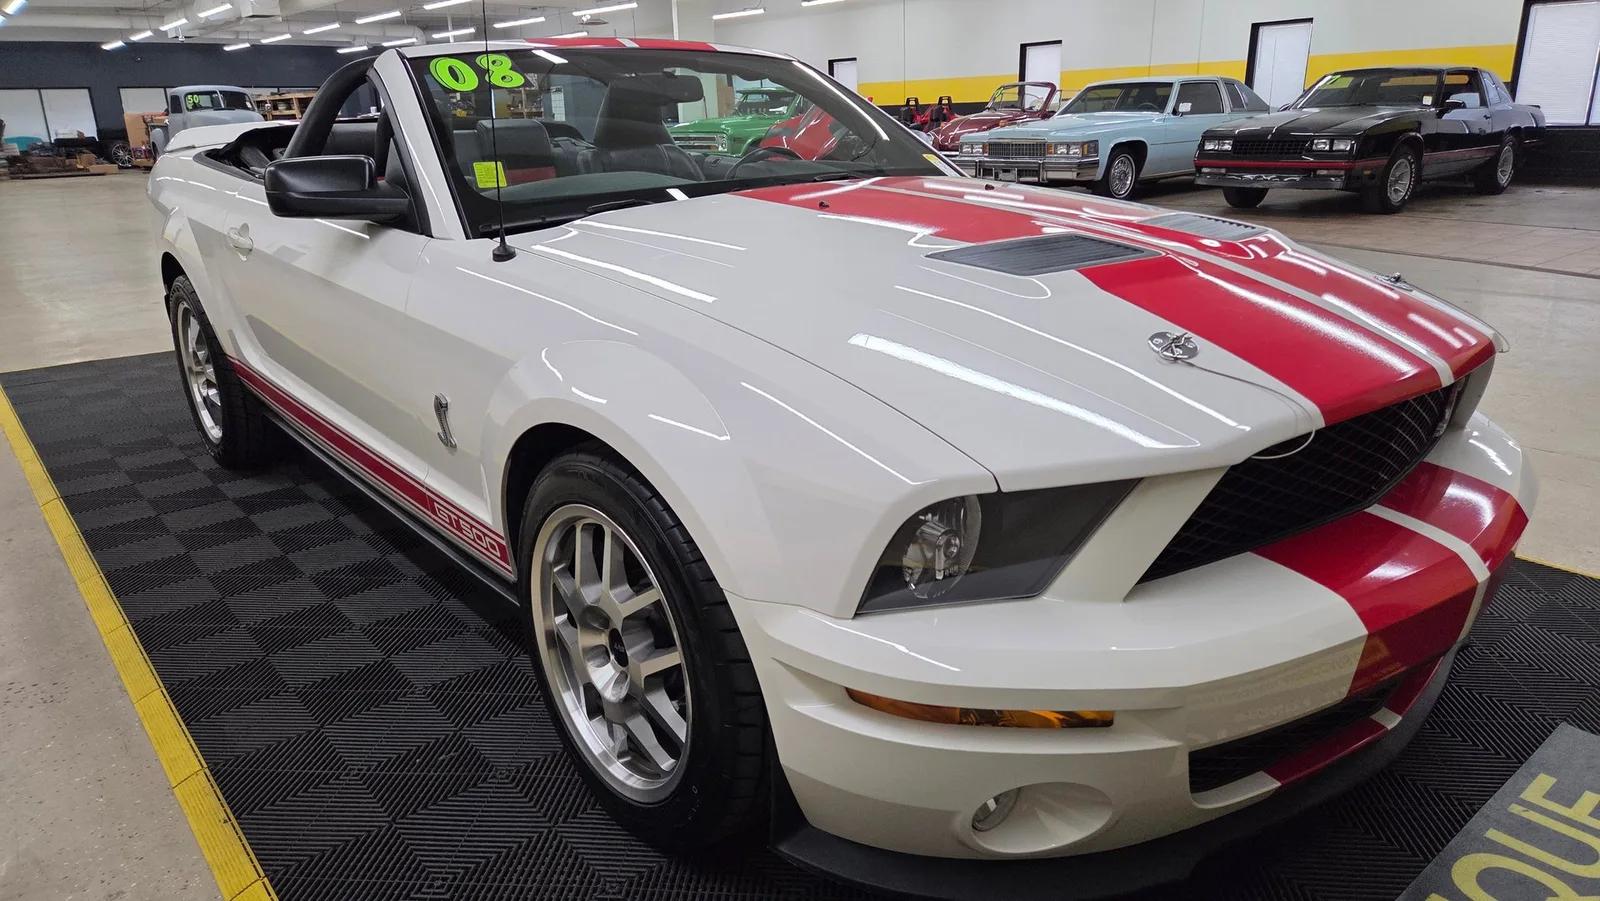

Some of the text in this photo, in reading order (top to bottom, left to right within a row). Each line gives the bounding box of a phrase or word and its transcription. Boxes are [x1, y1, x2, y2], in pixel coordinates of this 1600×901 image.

[429, 53, 525, 91] 08
[187, 94, 199, 104] 50
[1425, 773, 1600, 901] QUE
